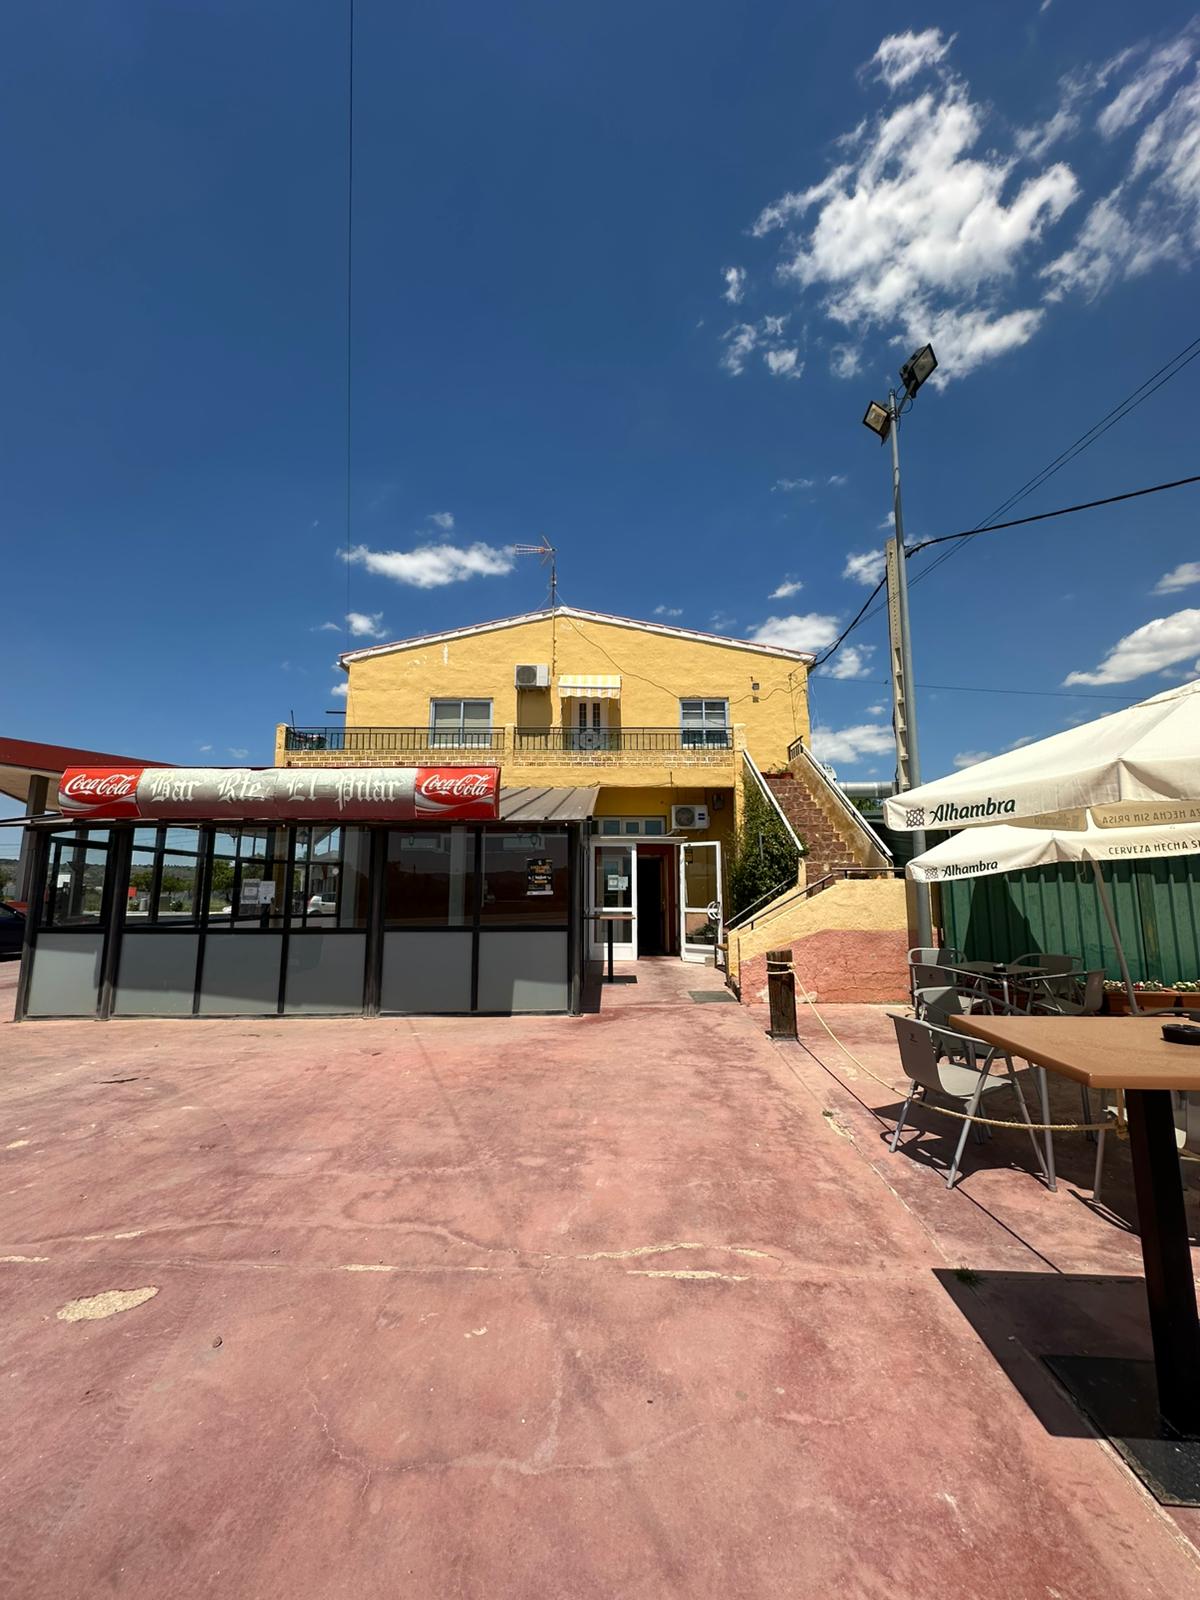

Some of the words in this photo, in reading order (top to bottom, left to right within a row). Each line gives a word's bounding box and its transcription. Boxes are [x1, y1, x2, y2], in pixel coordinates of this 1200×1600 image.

[64, 773, 139, 796] Coca-Cola
[149, 772, 200, 802] Bar
[335, 771, 403, 812] Pilar
[421, 773, 491, 796] Coca-Cola
[929, 797, 1016, 825] Alhambra
[1108, 844, 1152, 855] CERVEZA
[1153, 841, 1188, 851] HECHA
[941, 861, 998, 878] Alhambra
